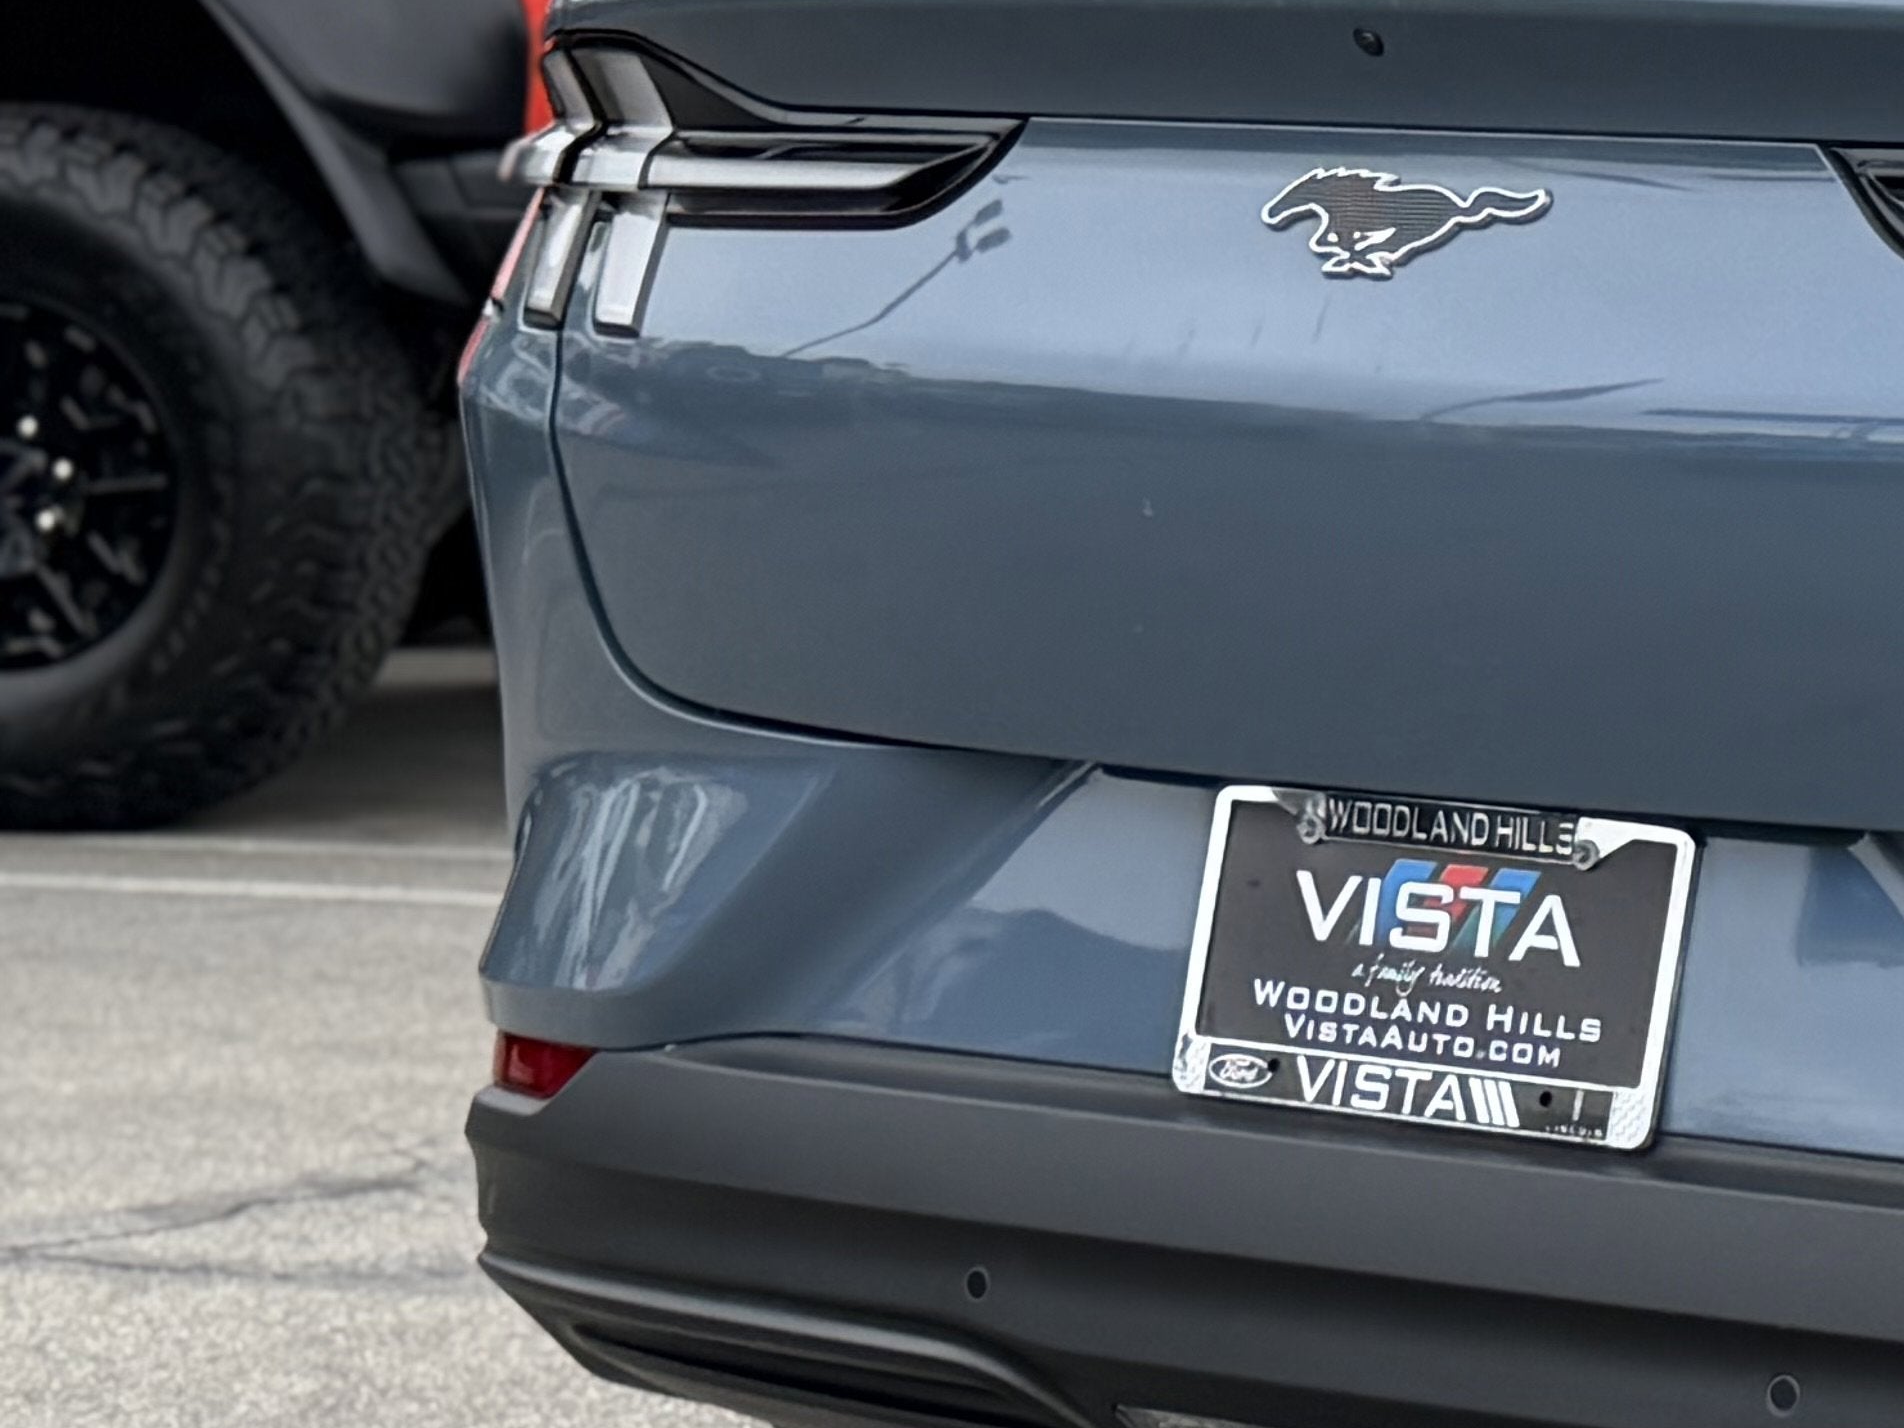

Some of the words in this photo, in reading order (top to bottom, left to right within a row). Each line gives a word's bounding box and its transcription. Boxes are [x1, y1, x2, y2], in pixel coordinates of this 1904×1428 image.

[1328, 797, 1491, 847] WOODLAND
[1496, 815, 1574, 856] HILLS
[1296, 869, 1582, 968] VISTA
[1253, 977, 1470, 1028] WOODLAND
[1486, 1003, 1602, 1043] HILLS
[1296, 1054, 1472, 1123] VISTA
